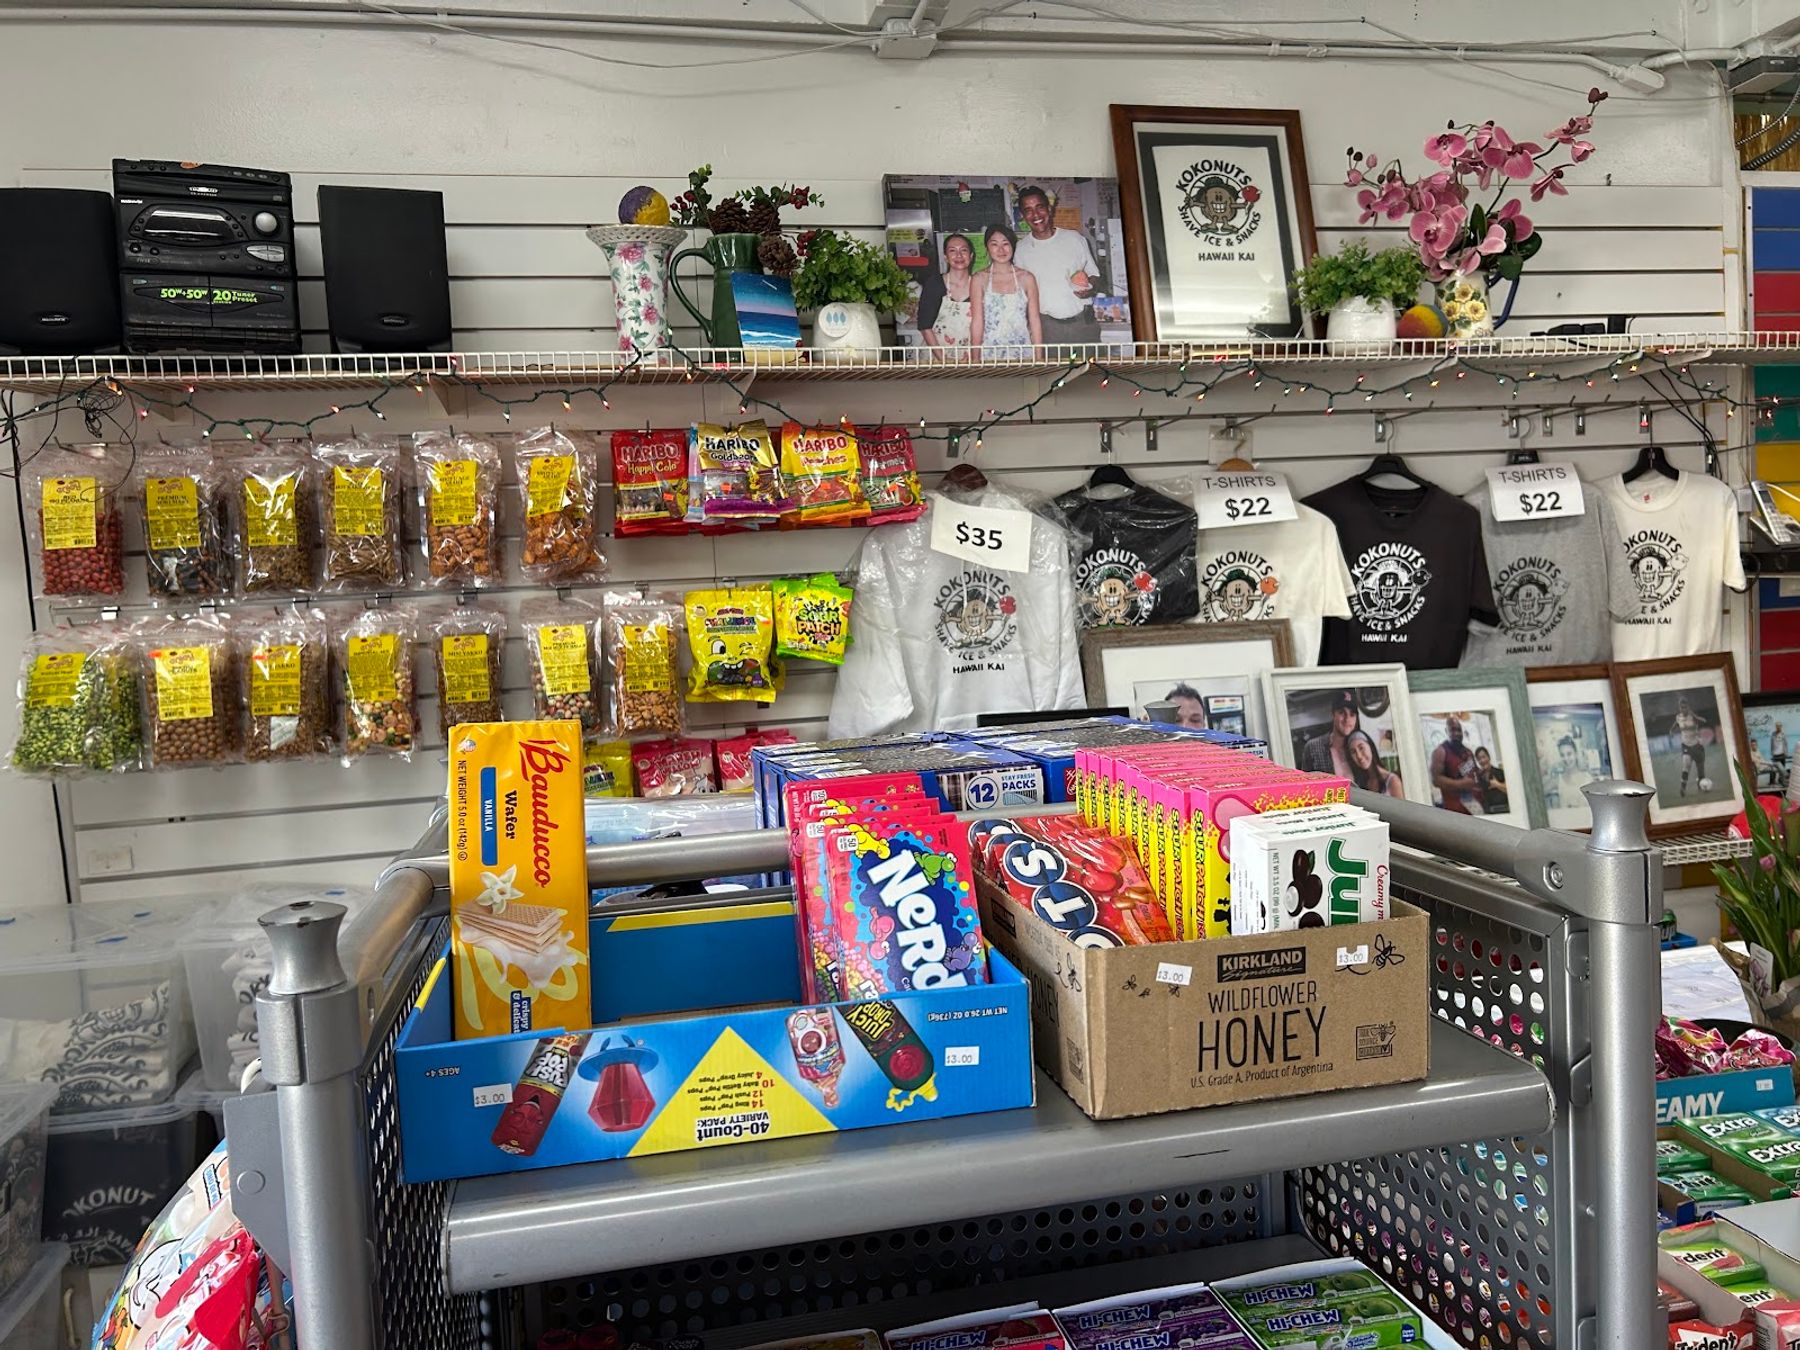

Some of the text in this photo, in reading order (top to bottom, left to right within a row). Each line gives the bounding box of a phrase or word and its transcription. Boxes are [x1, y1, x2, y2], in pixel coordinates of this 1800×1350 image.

[1176, 159, 1252, 192] KOKONUTS
[1178, 203, 1261, 247] SHAVE ICE & SNACKS
[1198, 252, 1255, 261] HAWAII KAI
[213, 290, 231, 301] 20
[621, 444, 680, 462] HARIBO
[705, 437, 760, 451] HARIBO
[792, 436, 848, 453] HARIBO
[861, 440, 908, 457] HARIBO
[1203, 475, 1277, 490] T-SHIRTS
[1498, 467, 1567, 484] T-SHIRTS
[1224, 497, 1272, 520] $22
[1520, 491, 1562, 515] $22
[955, 521, 1003, 550] $35
[1201, 550, 1273, 588] KOKONUTS
[1351, 542, 1426, 578] KOKONUTS
[1493, 556, 1561, 592] KOKONUTS
[934, 570, 1011, 608] KOKONUTS
[1659, 579, 1686, 611] SNACKS
[1366, 619, 1384, 632] ICE
[1384, 621, 1392, 631] &
[1395, 596, 1426, 628] SNACKS
[1539, 606, 1567, 637] SNACKS
[1657, 617, 1672, 625] KAI
[797, 621, 841, 635] PATCH
[1361, 633, 1408, 643] HAWAII KAI
[988, 624, 1017, 655] SNACKS
[1506, 644, 1552, 655] HAWAII KAI
[953, 663, 1005, 674] HAWAII KAI
[457, 760, 467, 775] NET
[457, 776, 467, 800] WEIGHT
[970, 782, 995, 804] 12
[1002, 779, 1036, 791] PACKS
[484, 799, 493, 832] VANILLA
[504, 790, 518, 840] Wafer
[519, 739, 573, 889] Bauducco
[1155, 801, 1166, 852] SOUR
[1171, 808, 1183, 860] SOUR
[1194, 808, 1206, 863] SOUR
[1372, 864, 1388, 911] Creamy
[1222, 950, 1303, 971] KIRKLAND
[1221, 967, 1304, 981] Signature
[1207, 980, 1317, 1014] WILDFLOWER
[863, 1001, 894, 1025] DROP
[953, 1011, 963, 1019] OZ
[981, 1007, 993, 1016] WT
[994, 1007, 1008, 1015] NET
[846, 1006, 892, 1039] JUICY
[1198, 1005, 1327, 1073] HONEY
[439, 1067, 460, 1077] AGES
[536, 1052, 569, 1073] POP
[526, 1062, 568, 1089] PUSH
[756, 1071, 763, 1079] 4
[762, 1079, 775, 1088] 10
[1208, 1074, 1233, 1087] Grade
[1245, 1068, 1279, 1082] Product
[1281, 1066, 1290, 1077] of
[1291, 1061, 1334, 1078] Argentina
[475, 1093, 505, 1105] $3.00
[751, 1099, 764, 1109] 14
[752, 1090, 763, 1098] 12
[697, 1112, 769, 1128] VARIETY PACK:
[697, 1121, 770, 1141] 40-Count
[1699, 1116, 1760, 1138] Extra
[1244, 1283, 1316, 1305] HI-CHEW
[1080, 1304, 1151, 1329] HI-CHEW
[1267, 1308, 1340, 1332] HI-CHEW
